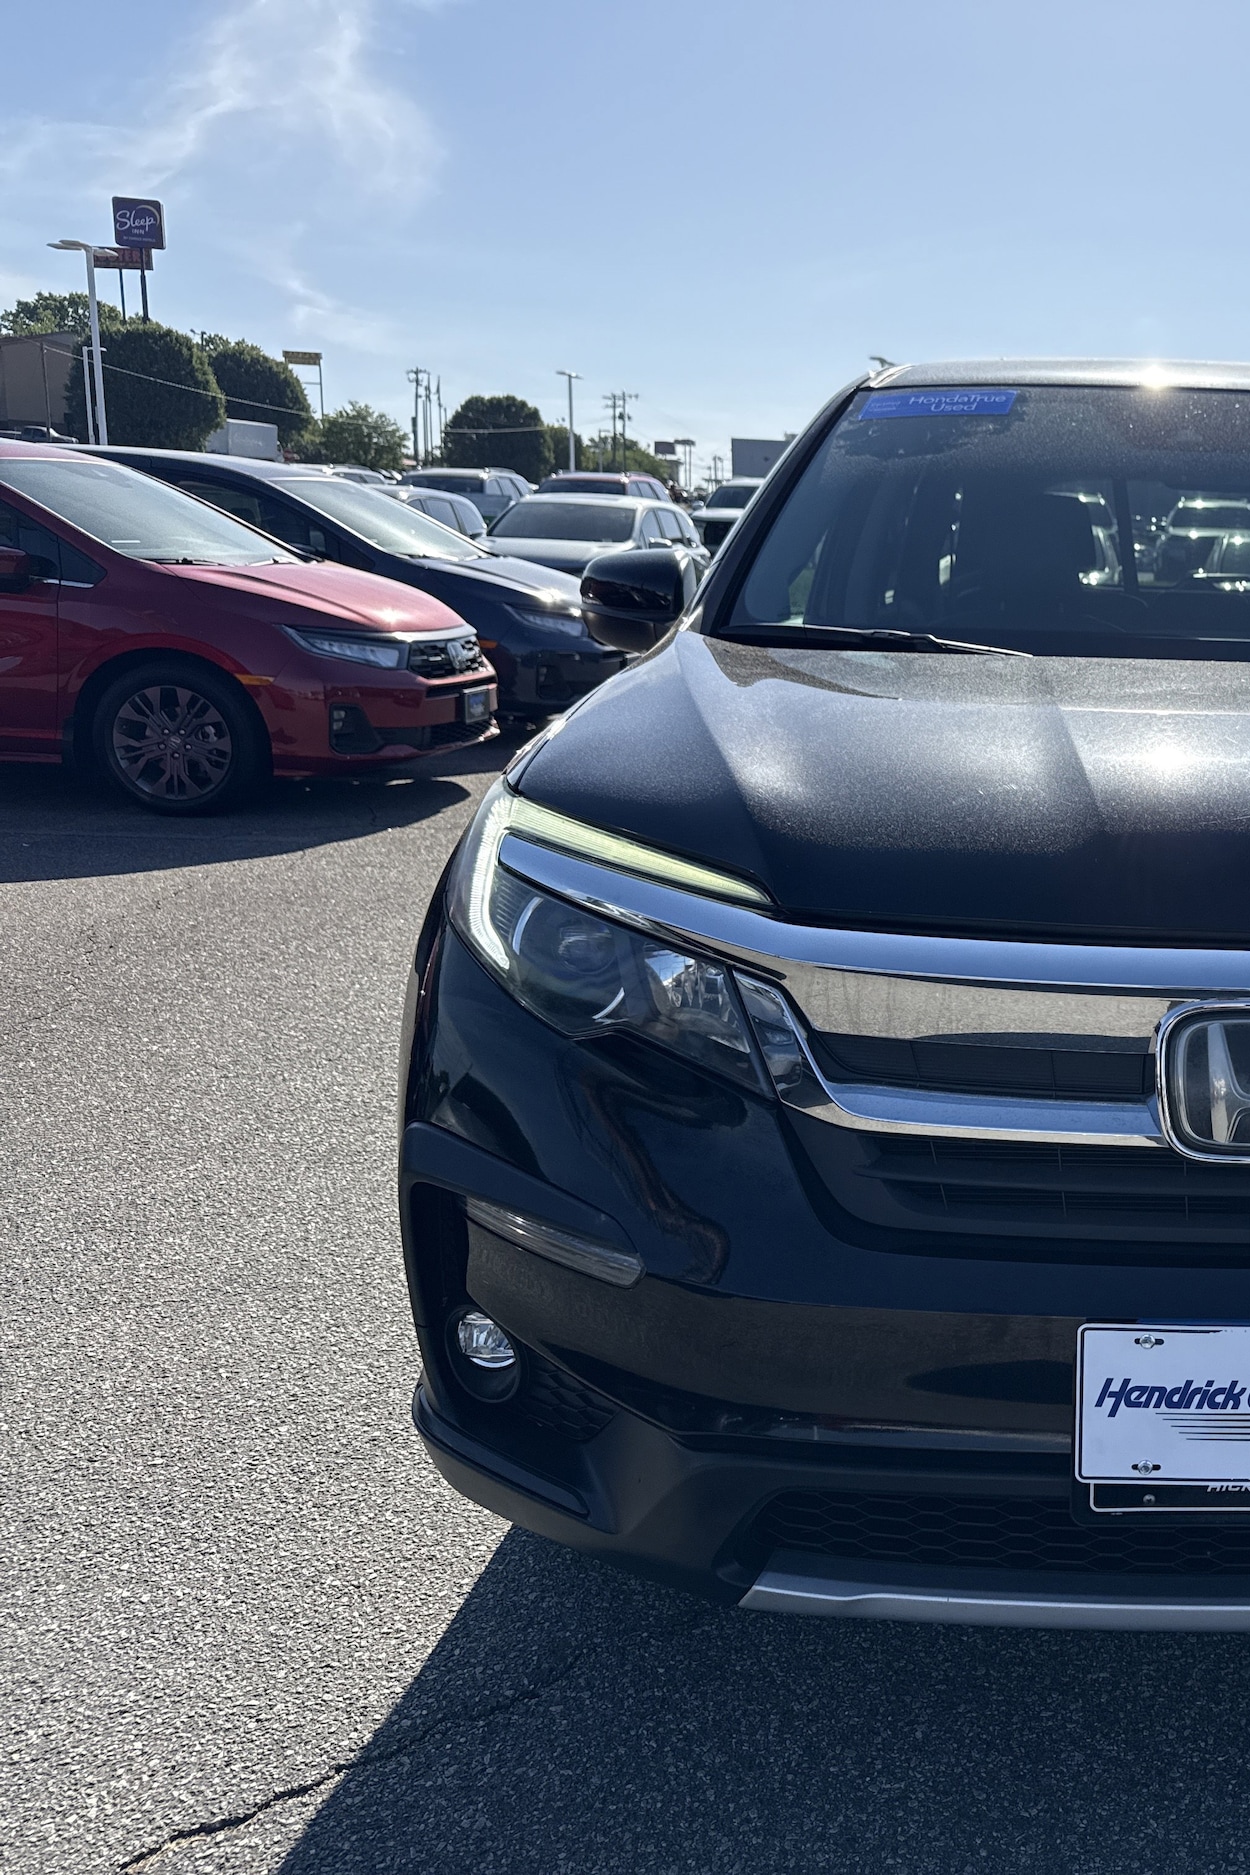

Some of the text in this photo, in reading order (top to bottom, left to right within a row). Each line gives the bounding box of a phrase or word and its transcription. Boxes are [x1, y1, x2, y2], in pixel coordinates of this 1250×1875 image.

[116, 210, 156, 231] Sleep
[909, 394, 1006, 404] HondaTrue
[930, 403, 977, 411] Used
[1095, 1378, 1246, 1417] Hendrick
